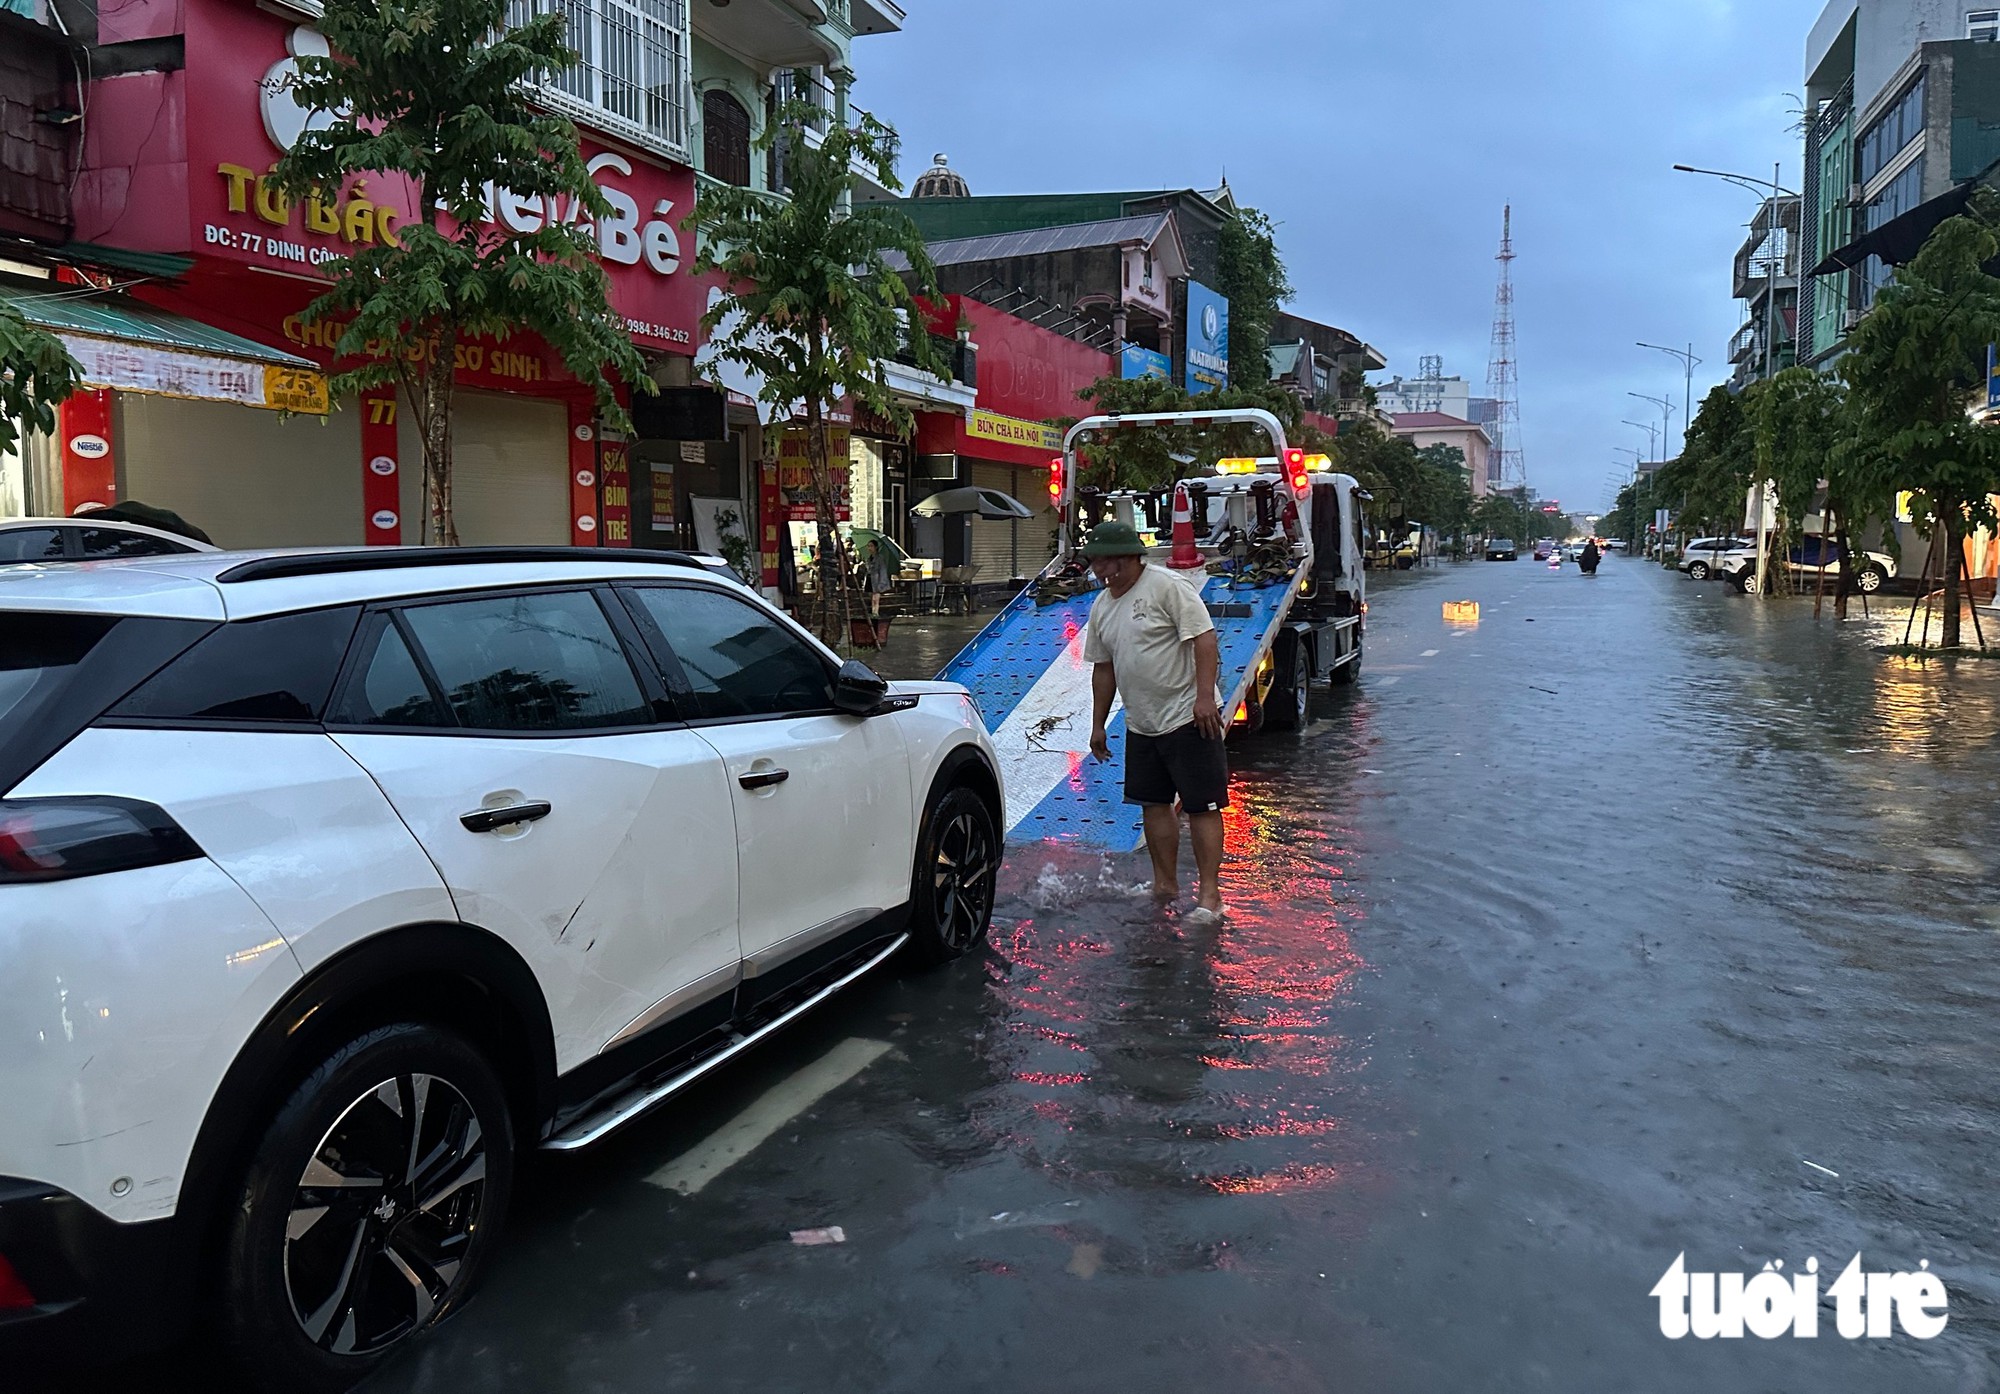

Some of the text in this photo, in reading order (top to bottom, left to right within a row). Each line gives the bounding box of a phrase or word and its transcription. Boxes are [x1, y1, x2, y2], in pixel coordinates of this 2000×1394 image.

[305, 179, 400, 247] BẮC
[204, 223, 238, 248] ĐC:
[240, 231, 262, 253] 77
[266, 238, 306, 264] ĐINH
[600, 185, 681, 275] Bé
[490, 351, 542, 382] SINH
[1188, 347, 1229, 375] NATRUMAX
[368, 398, 396, 425] 77
[977, 417, 994, 434] BÚN
[996, 420, 1012, 438] CHẢ
[1026, 427, 1039, 446] NỘI
[605, 479, 628, 507] BỈM
[606, 514, 628, 540] TRẺ
